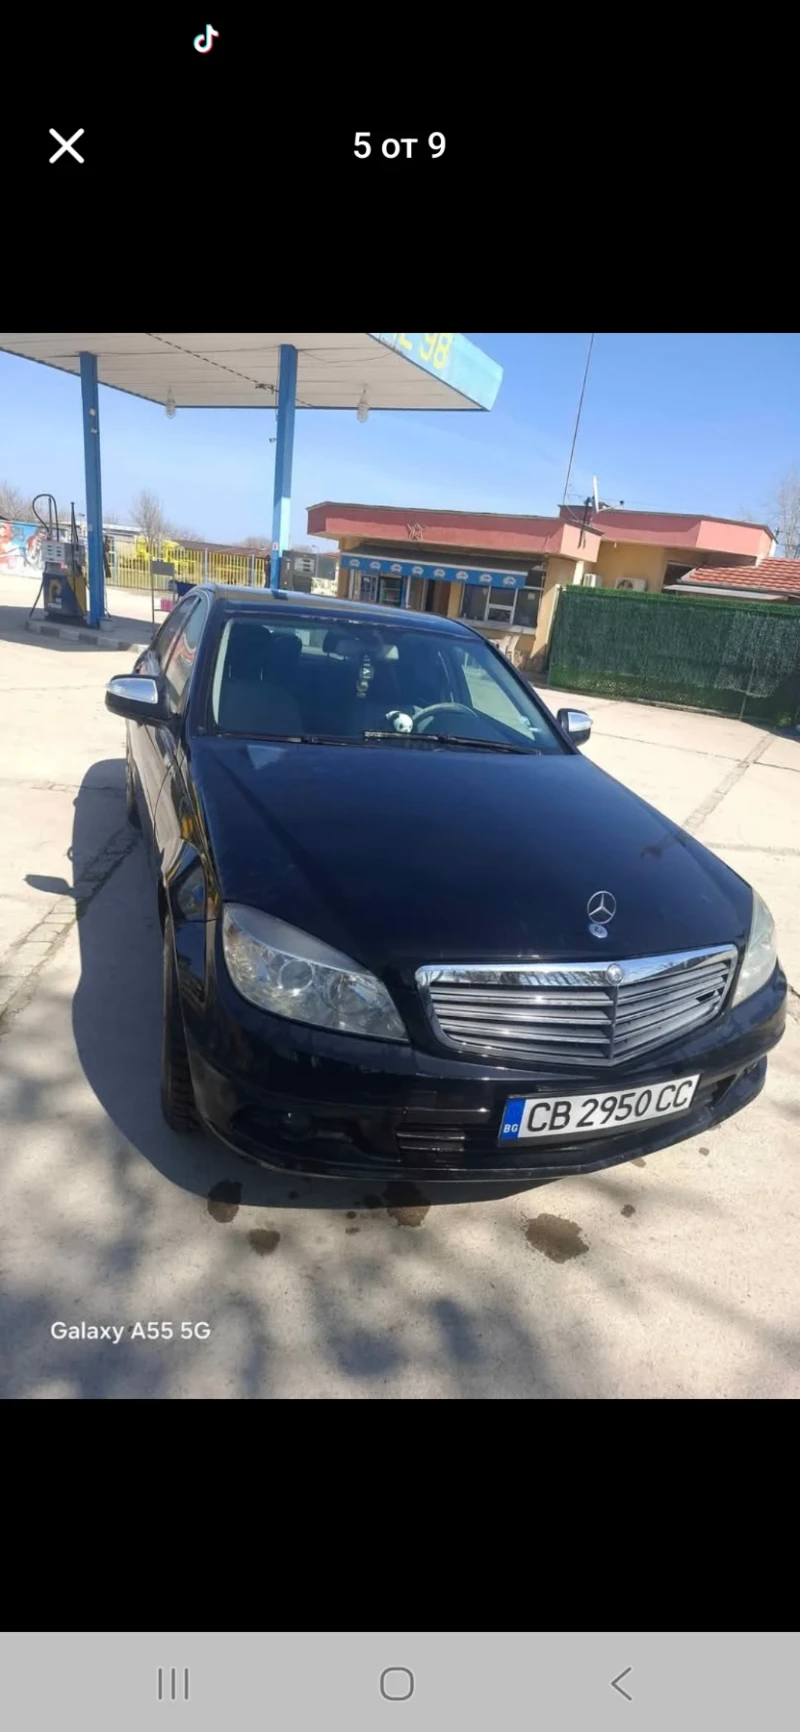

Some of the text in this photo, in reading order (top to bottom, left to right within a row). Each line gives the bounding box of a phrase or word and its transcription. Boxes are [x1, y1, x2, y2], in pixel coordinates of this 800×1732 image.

[419, 333, 453, 369] 98
[503, 1080, 693, 1134] BG CB 2950 CC
